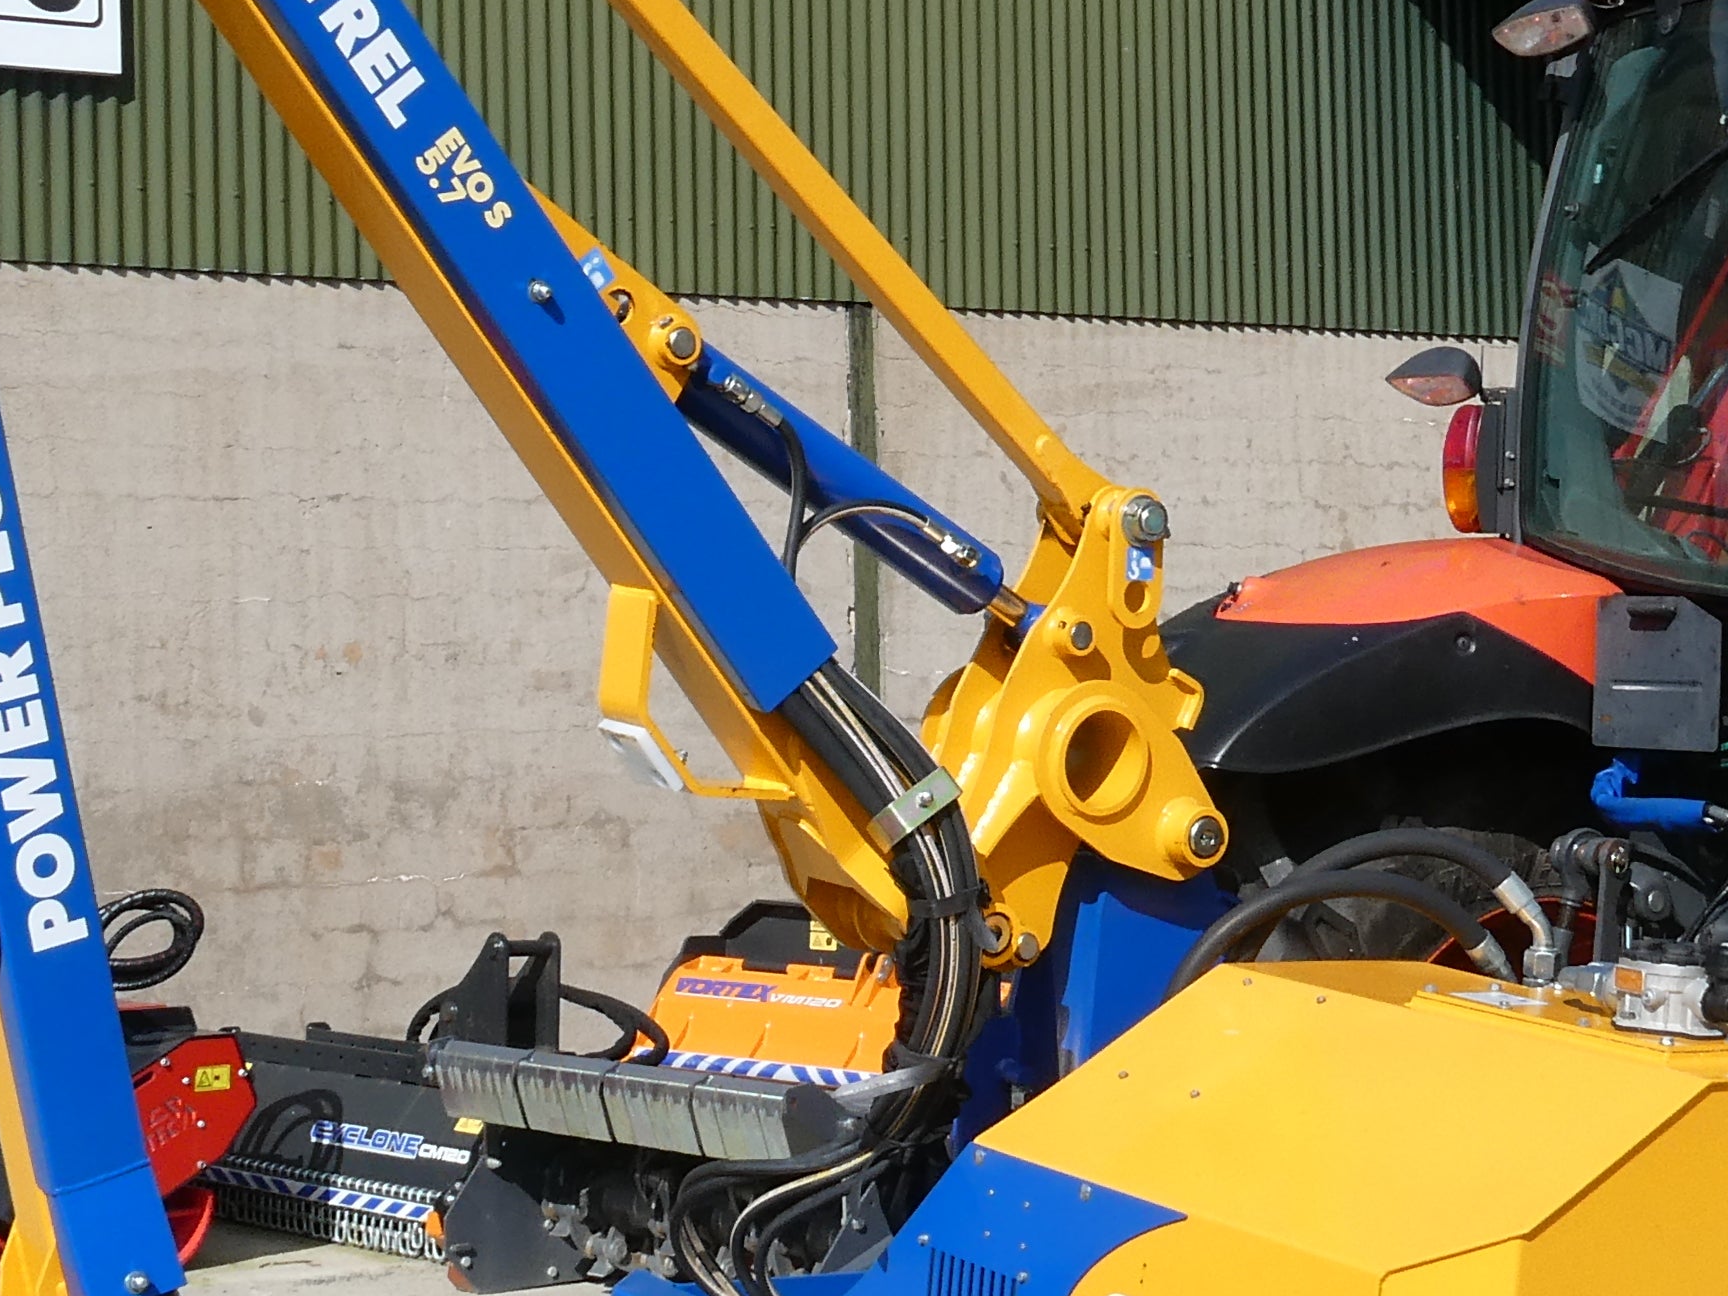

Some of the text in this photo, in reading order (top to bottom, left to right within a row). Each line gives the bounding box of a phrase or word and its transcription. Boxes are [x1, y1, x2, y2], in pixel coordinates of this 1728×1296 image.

[415, 142, 466, 204] 5.7
[434, 125, 495, 204] EVO
[675, 977, 843, 1009] VORTEX VM120
[418, 1143, 471, 1165] CM120
